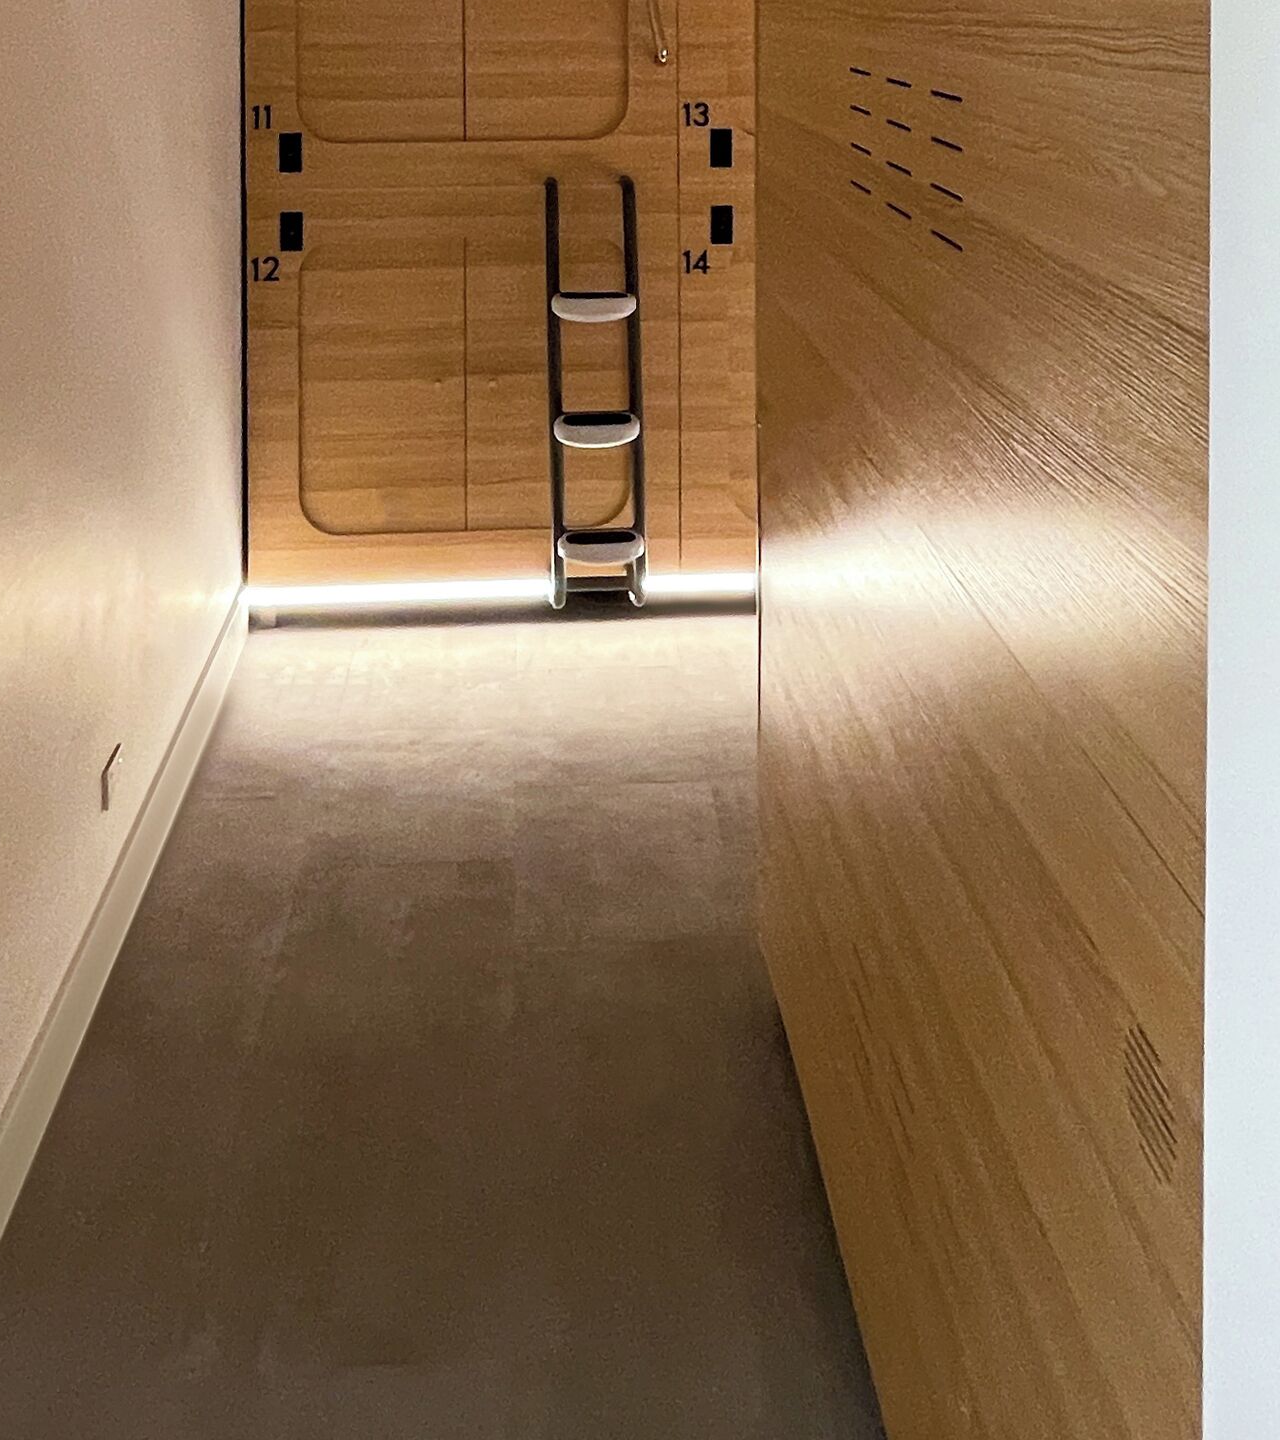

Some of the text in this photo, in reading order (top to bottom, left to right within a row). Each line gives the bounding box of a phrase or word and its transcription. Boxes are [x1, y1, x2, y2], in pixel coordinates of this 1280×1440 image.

[252, 104, 271, 130] 11
[682, 102, 710, 127] 13
[251, 256, 280, 282] 12
[682, 249, 710, 274] 14
